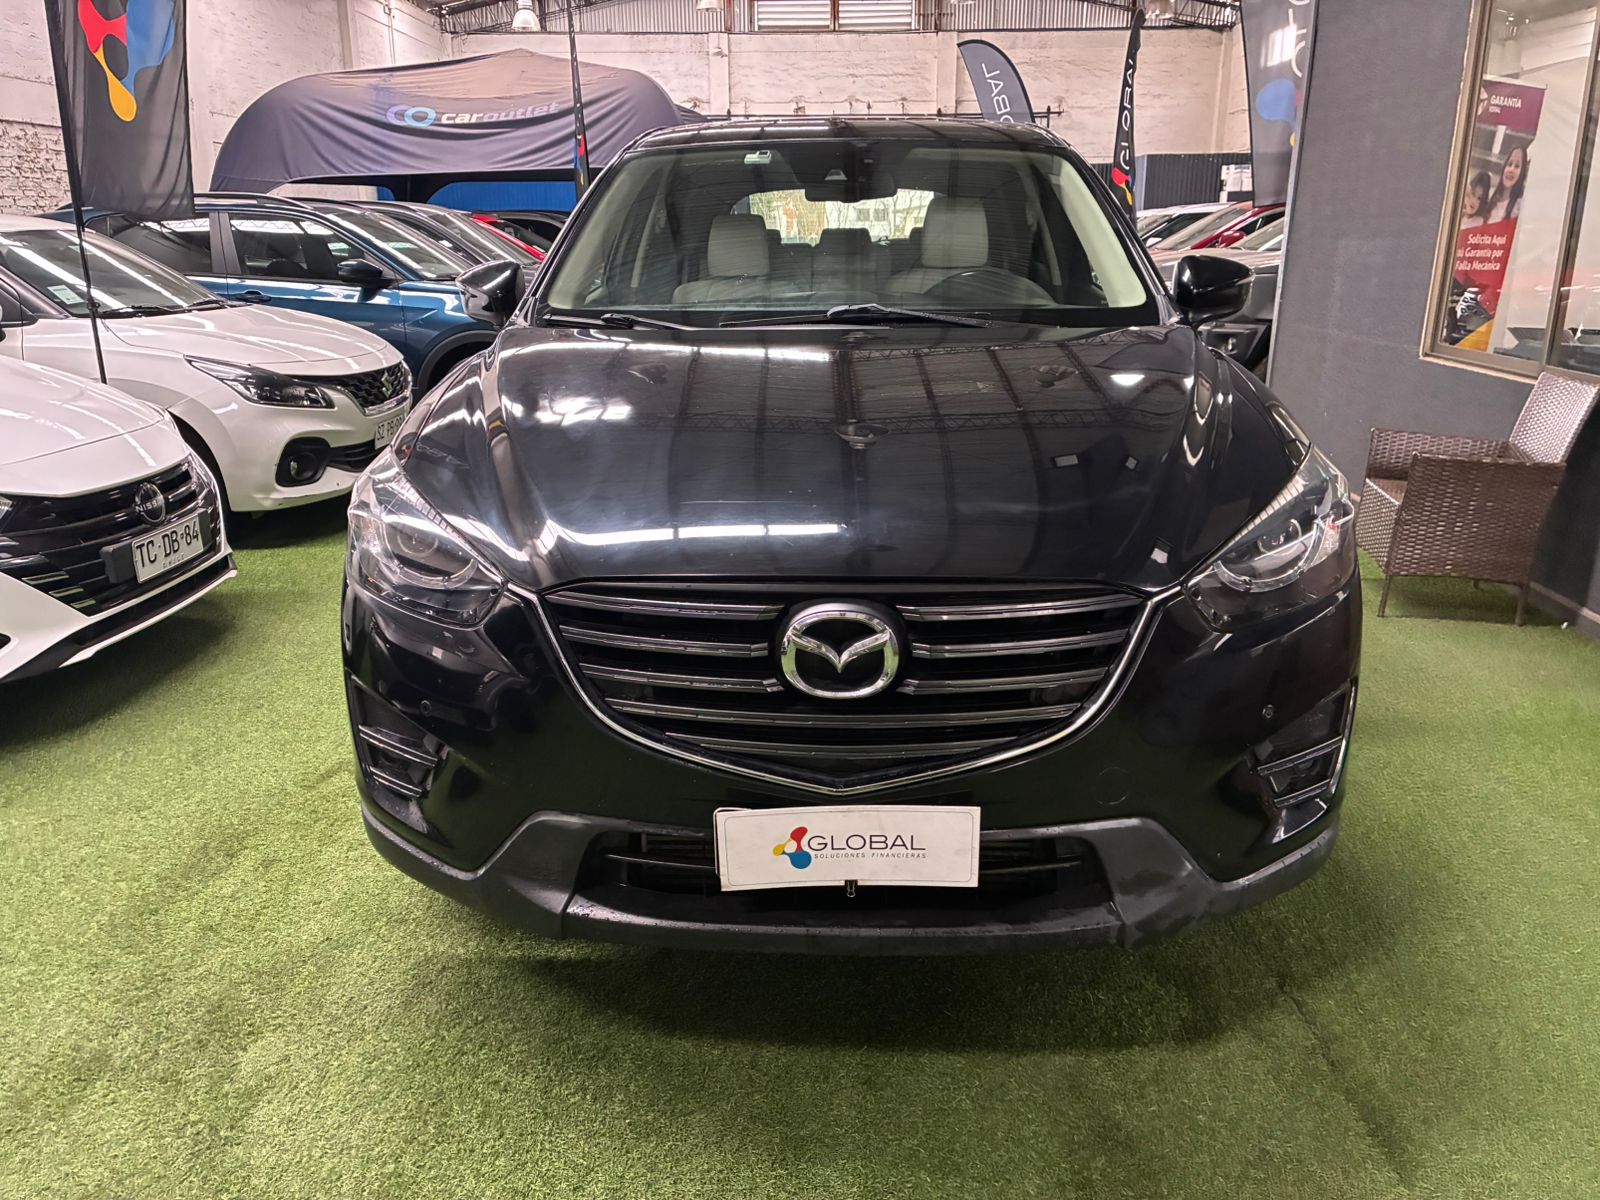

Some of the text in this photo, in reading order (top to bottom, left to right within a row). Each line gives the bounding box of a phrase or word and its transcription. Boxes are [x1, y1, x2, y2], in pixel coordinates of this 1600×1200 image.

[440, 102, 560, 124] caroutlet
[1467, 233, 1491, 245] Solicita
[1491, 249, 1504, 260] por
[135, 497, 162, 514] NISS
[807, 834, 926, 851] GLOBAL
